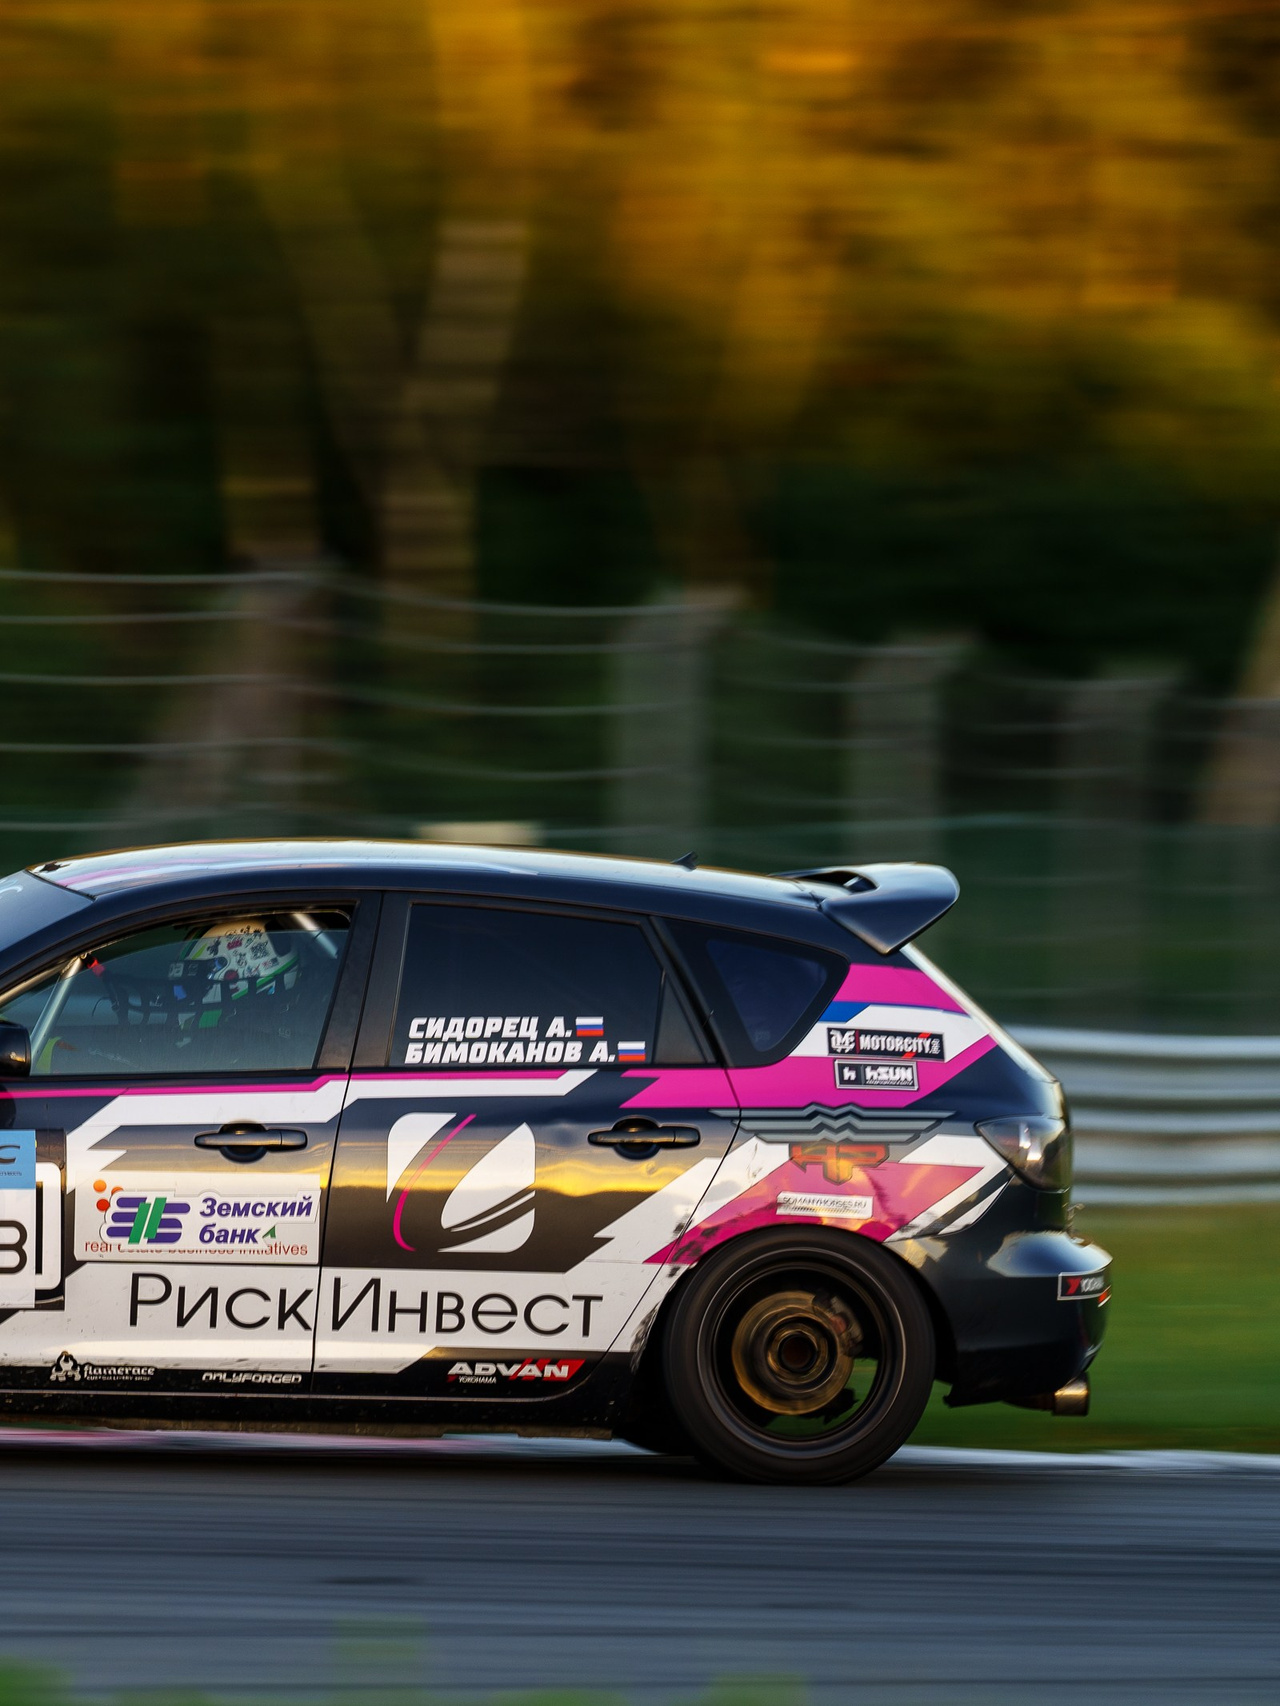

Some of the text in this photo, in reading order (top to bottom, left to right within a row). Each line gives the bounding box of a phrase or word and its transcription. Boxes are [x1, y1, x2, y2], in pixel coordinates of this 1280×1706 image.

[409, 1016, 572, 1041] СИДОРЕЦ А.
[404, 1041, 616, 1063] БИМОКАНОВ А.
[859, 1034, 932, 1054] MOTORCITY
[199, 1195, 314, 1218] Земский
[199, 1222, 261, 1244] банк
[447, 1361, 569, 1378] ADVAN
[458, 1375, 497, 1384] YOKOHAMA
